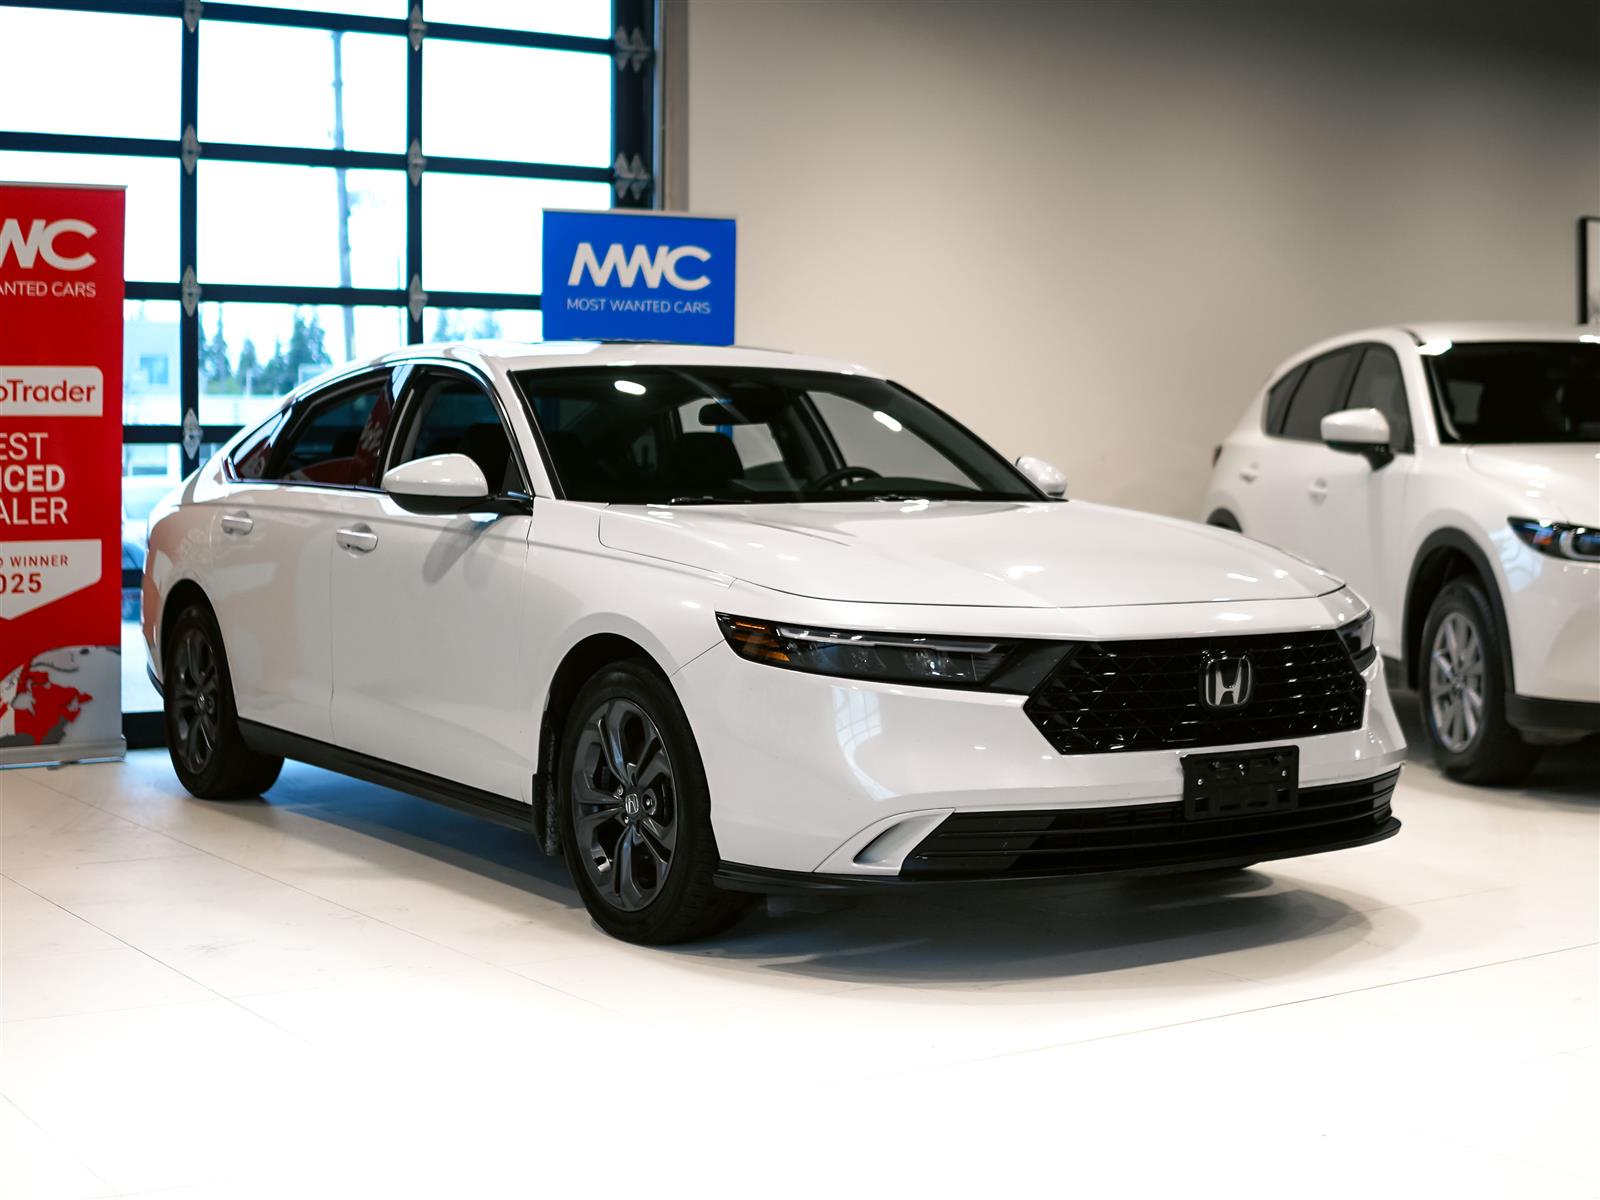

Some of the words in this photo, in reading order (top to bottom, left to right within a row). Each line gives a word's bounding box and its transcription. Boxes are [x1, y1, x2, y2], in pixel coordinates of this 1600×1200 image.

[568, 242, 711, 290] MWC
[51, 281, 97, 298] CARS
[567, 298, 606, 311] MOST
[609, 299, 671, 313] WANTED
[674, 301, 711, 314] CARS
[10, 555, 68, 568] WINNER
